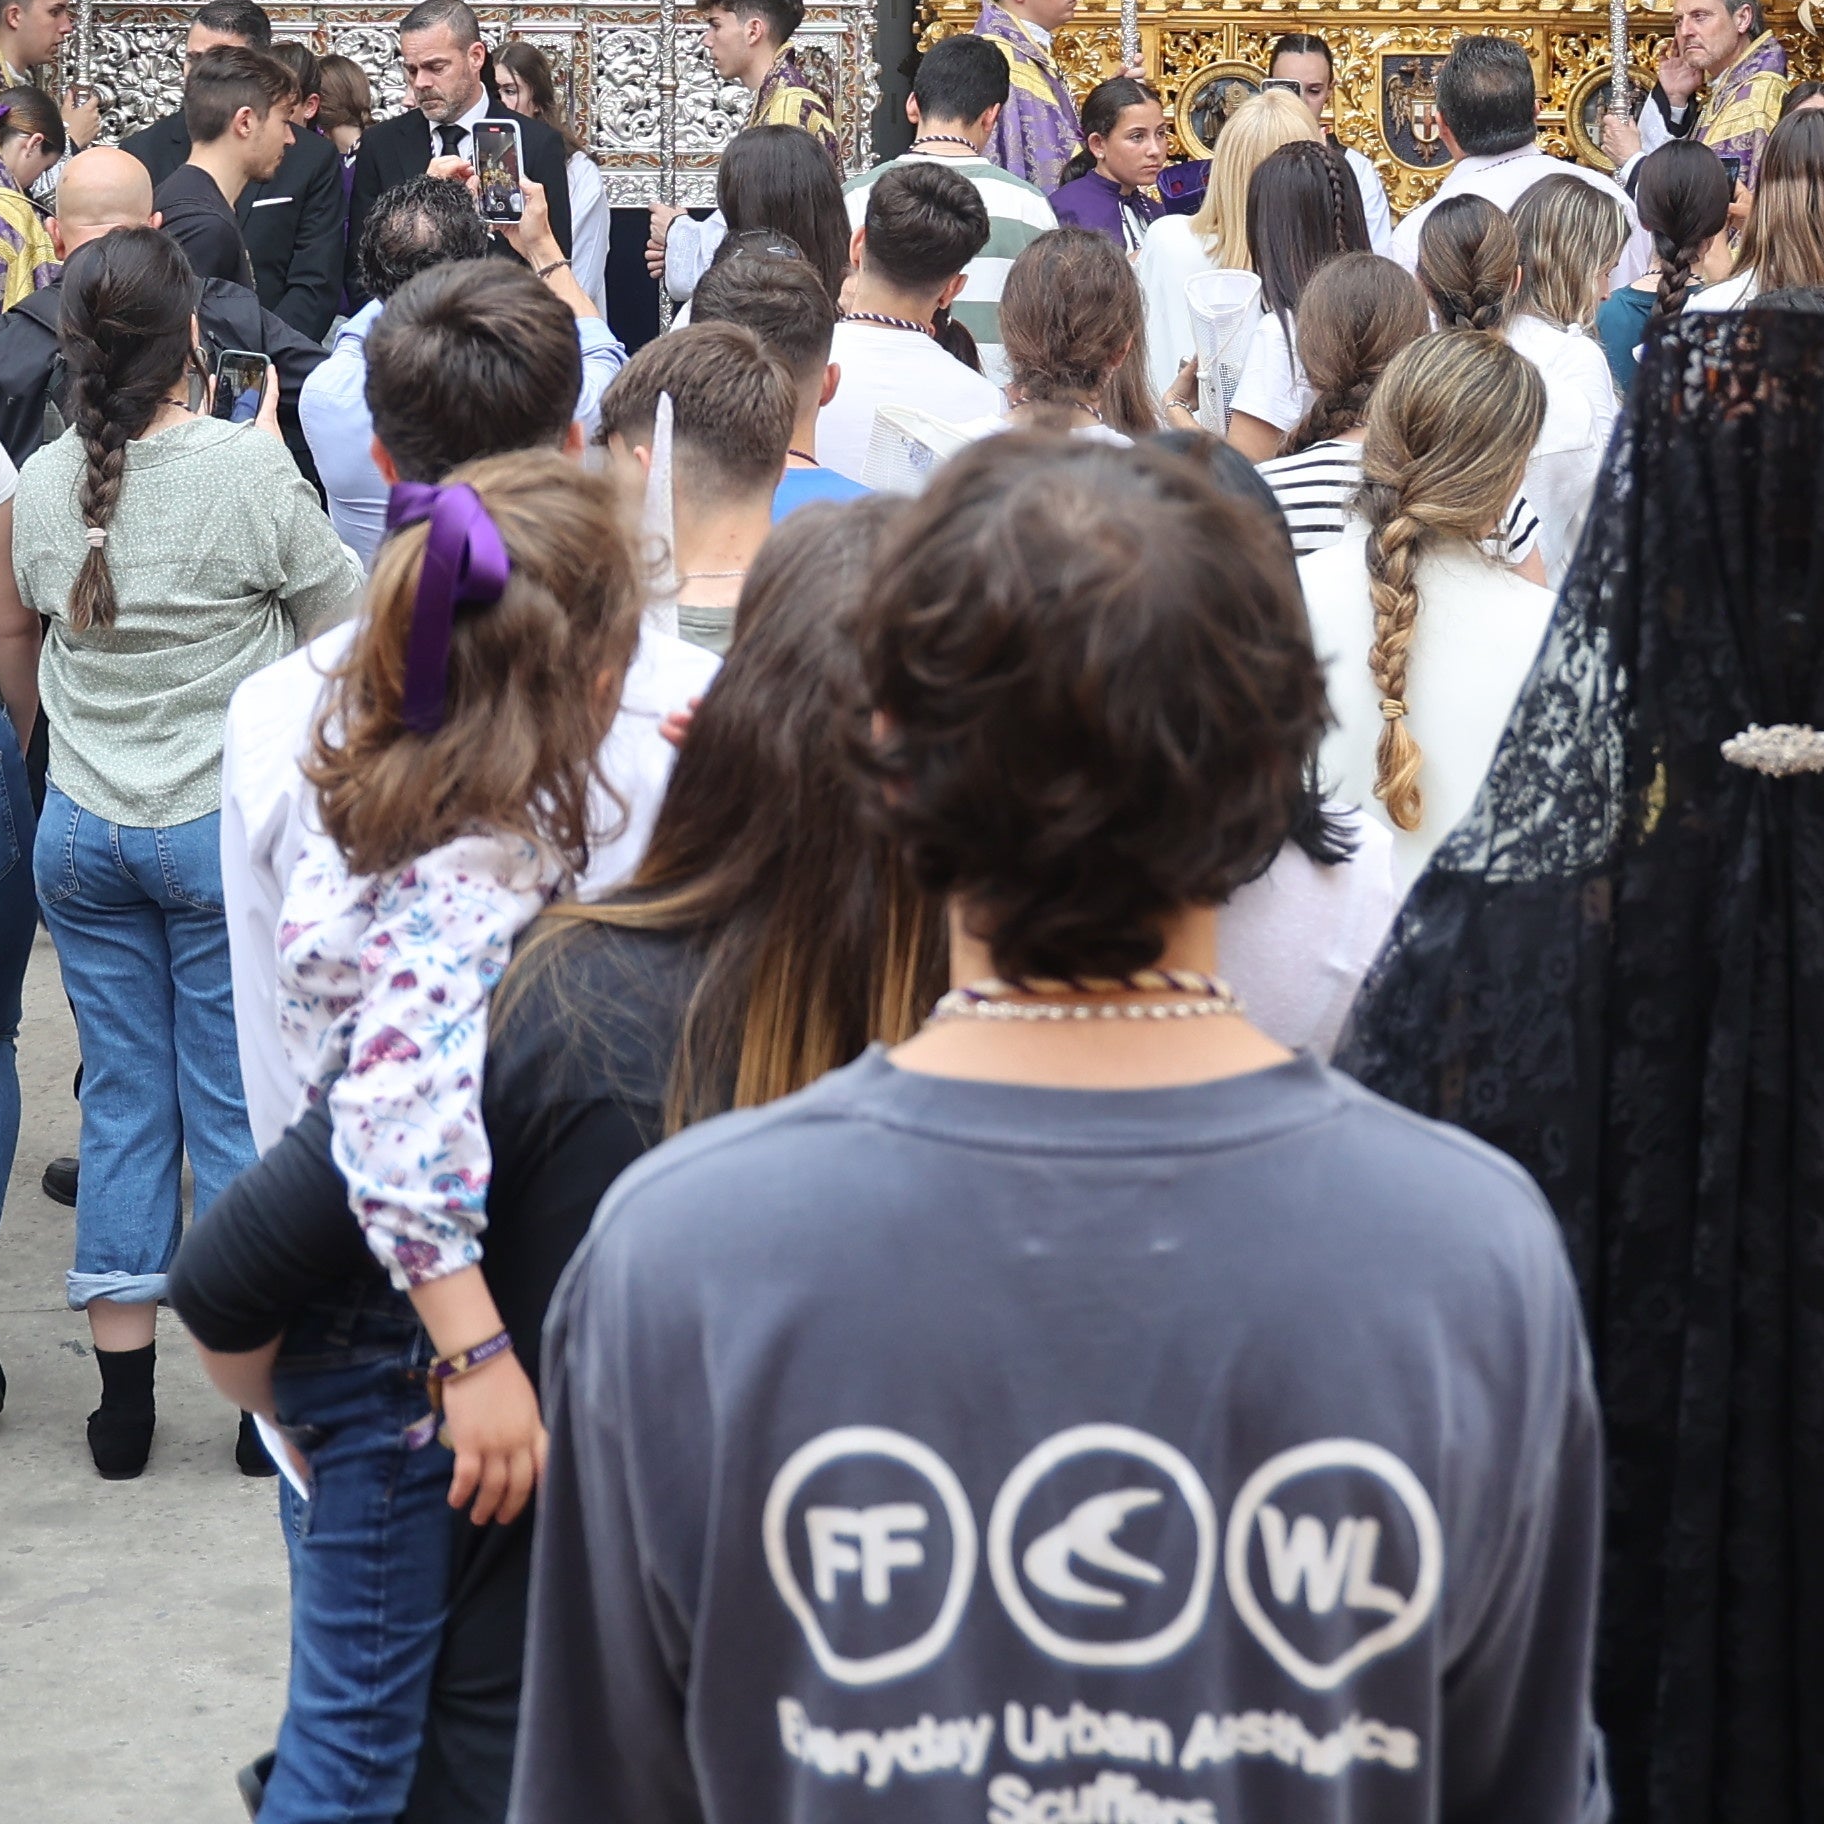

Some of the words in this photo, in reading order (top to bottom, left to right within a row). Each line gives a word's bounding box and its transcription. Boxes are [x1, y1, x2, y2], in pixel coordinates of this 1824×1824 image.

[805, 1504, 927, 1604] FF
[1259, 1504, 1409, 1613] WL
[1004, 1699, 1174, 1764] Urban
